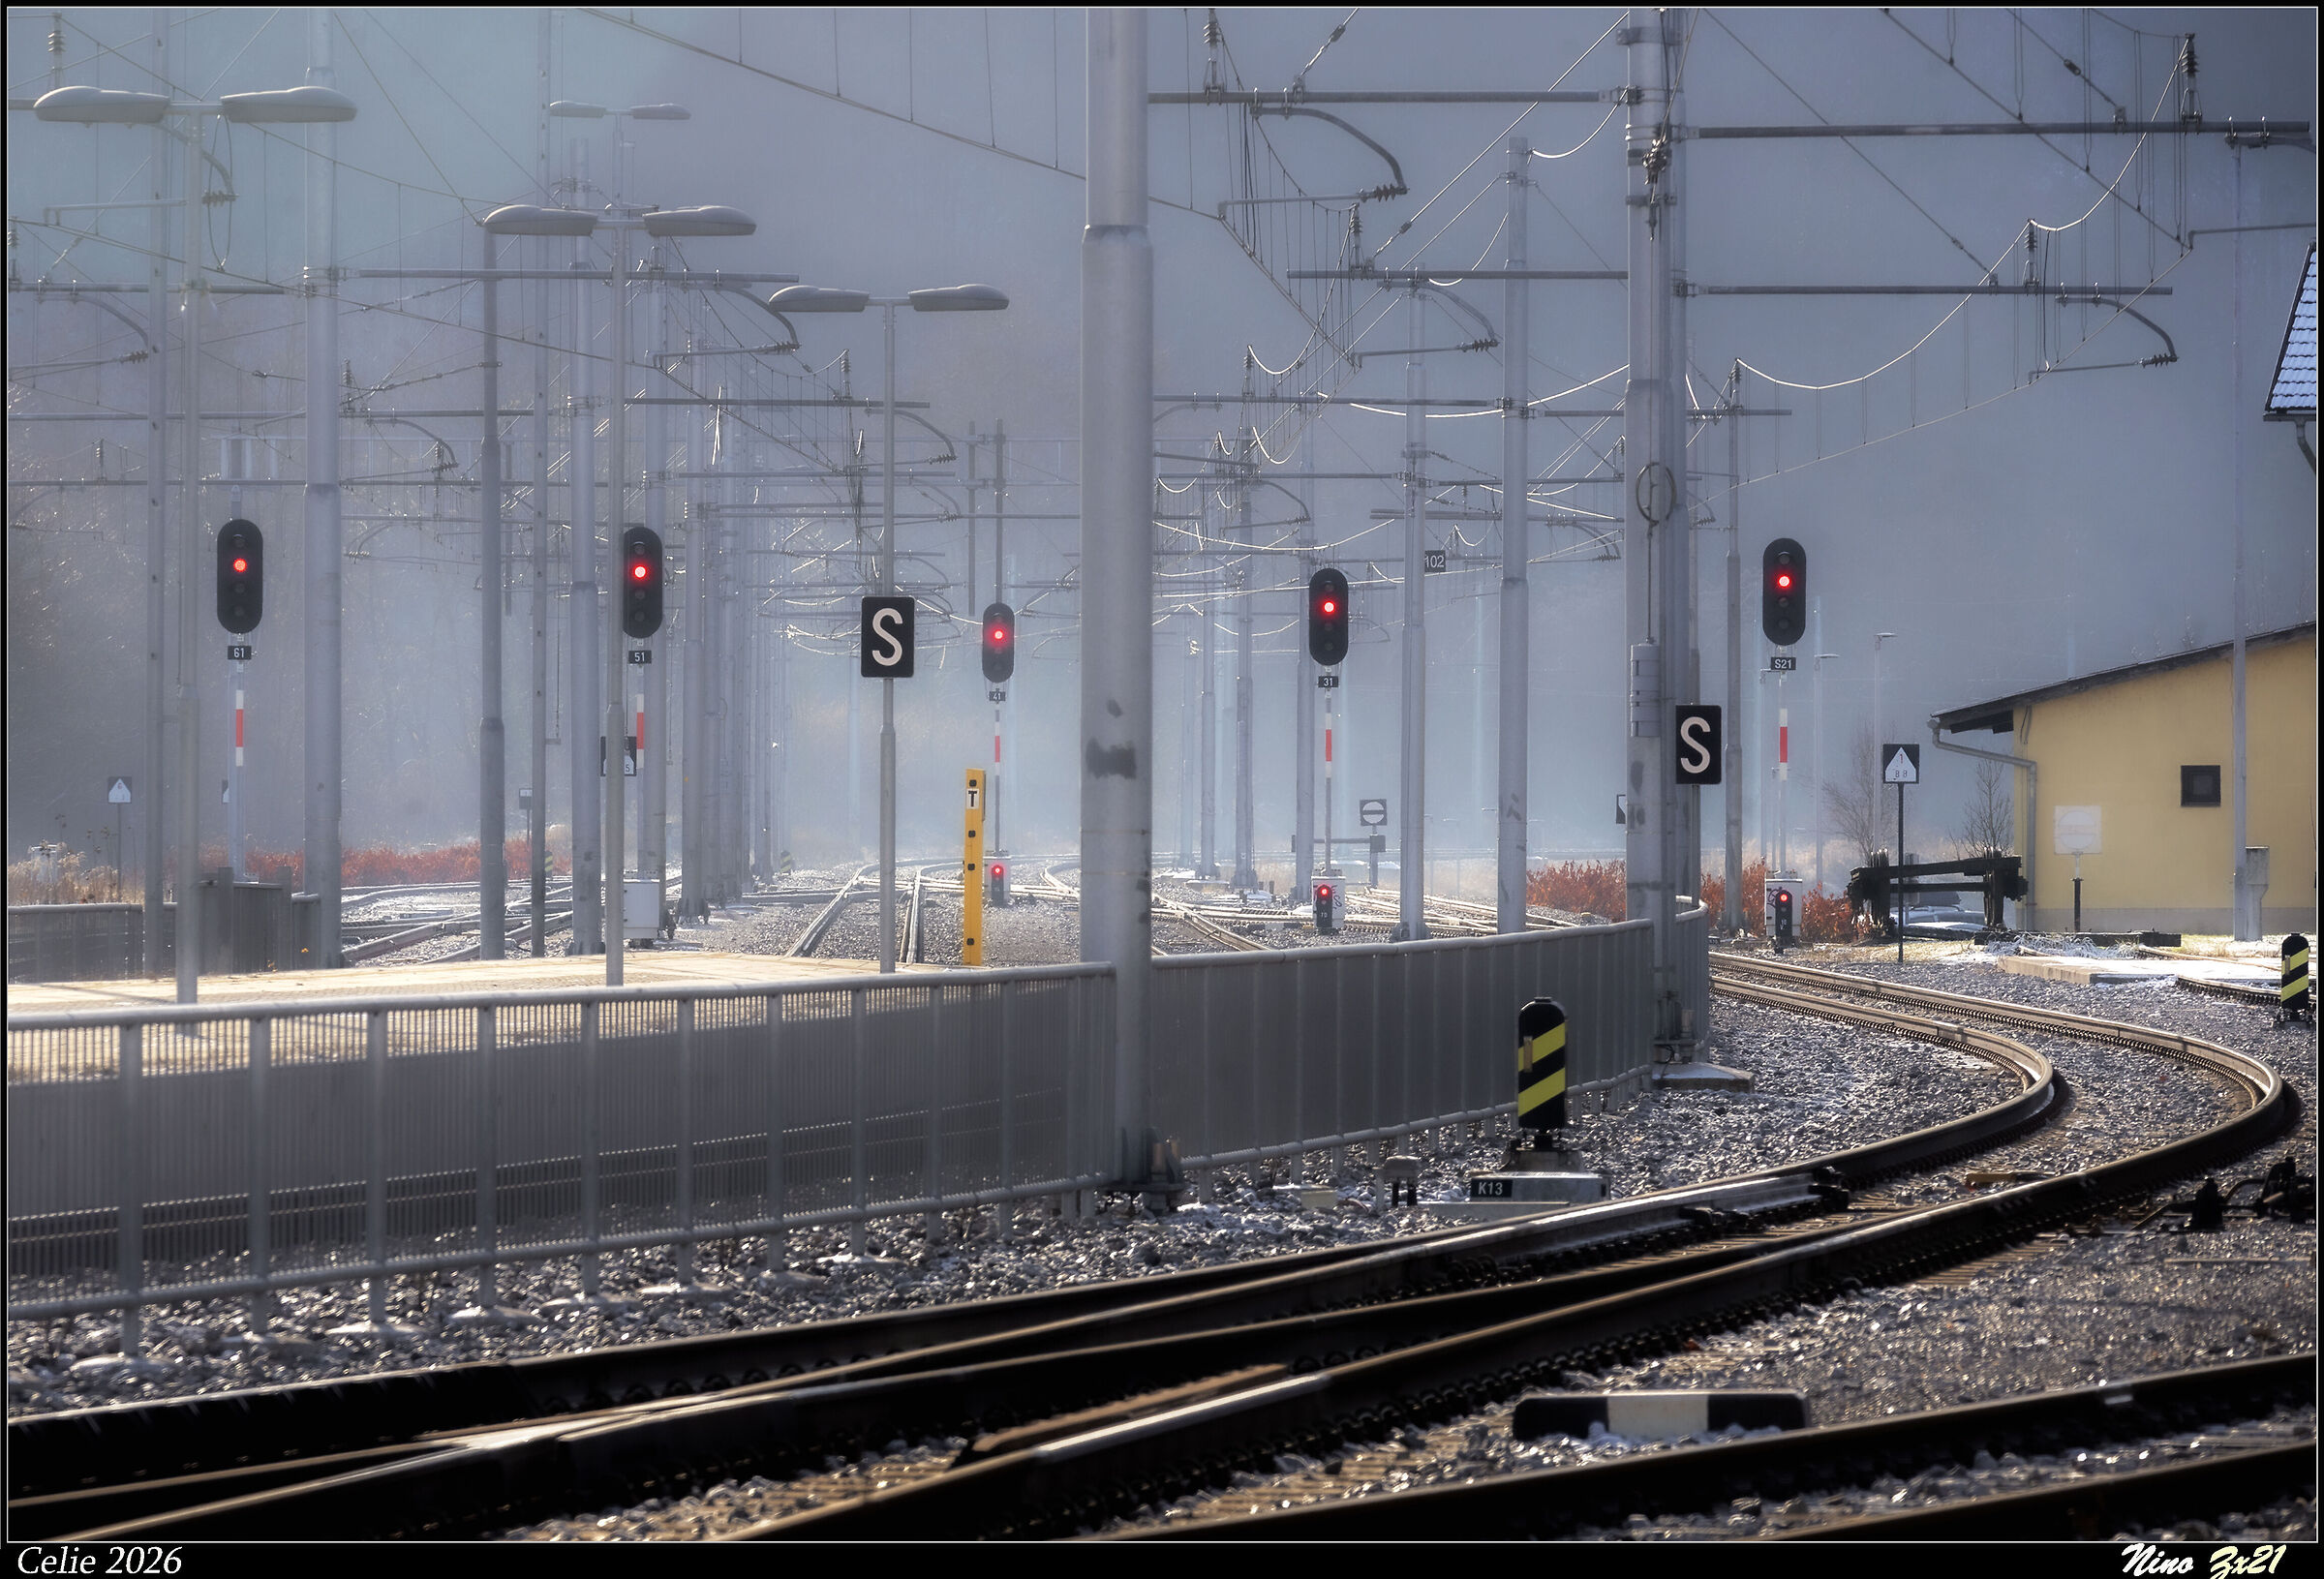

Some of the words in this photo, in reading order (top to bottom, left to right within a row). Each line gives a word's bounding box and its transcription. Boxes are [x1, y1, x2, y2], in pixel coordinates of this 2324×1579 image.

[1424, 555, 1445, 567] 102
[872, 608, 902, 666] S
[233, 648, 245, 658] 61
[634, 652, 645, 662] 51
[1775, 659, 1792, 670] S21
[1323, 678, 1333, 686] 31
[993, 692, 1001, 701] 41
[1680, 716, 1710, 774] S
[968, 790, 978, 807] T
[1478, 1182, 1503, 1196] K13
